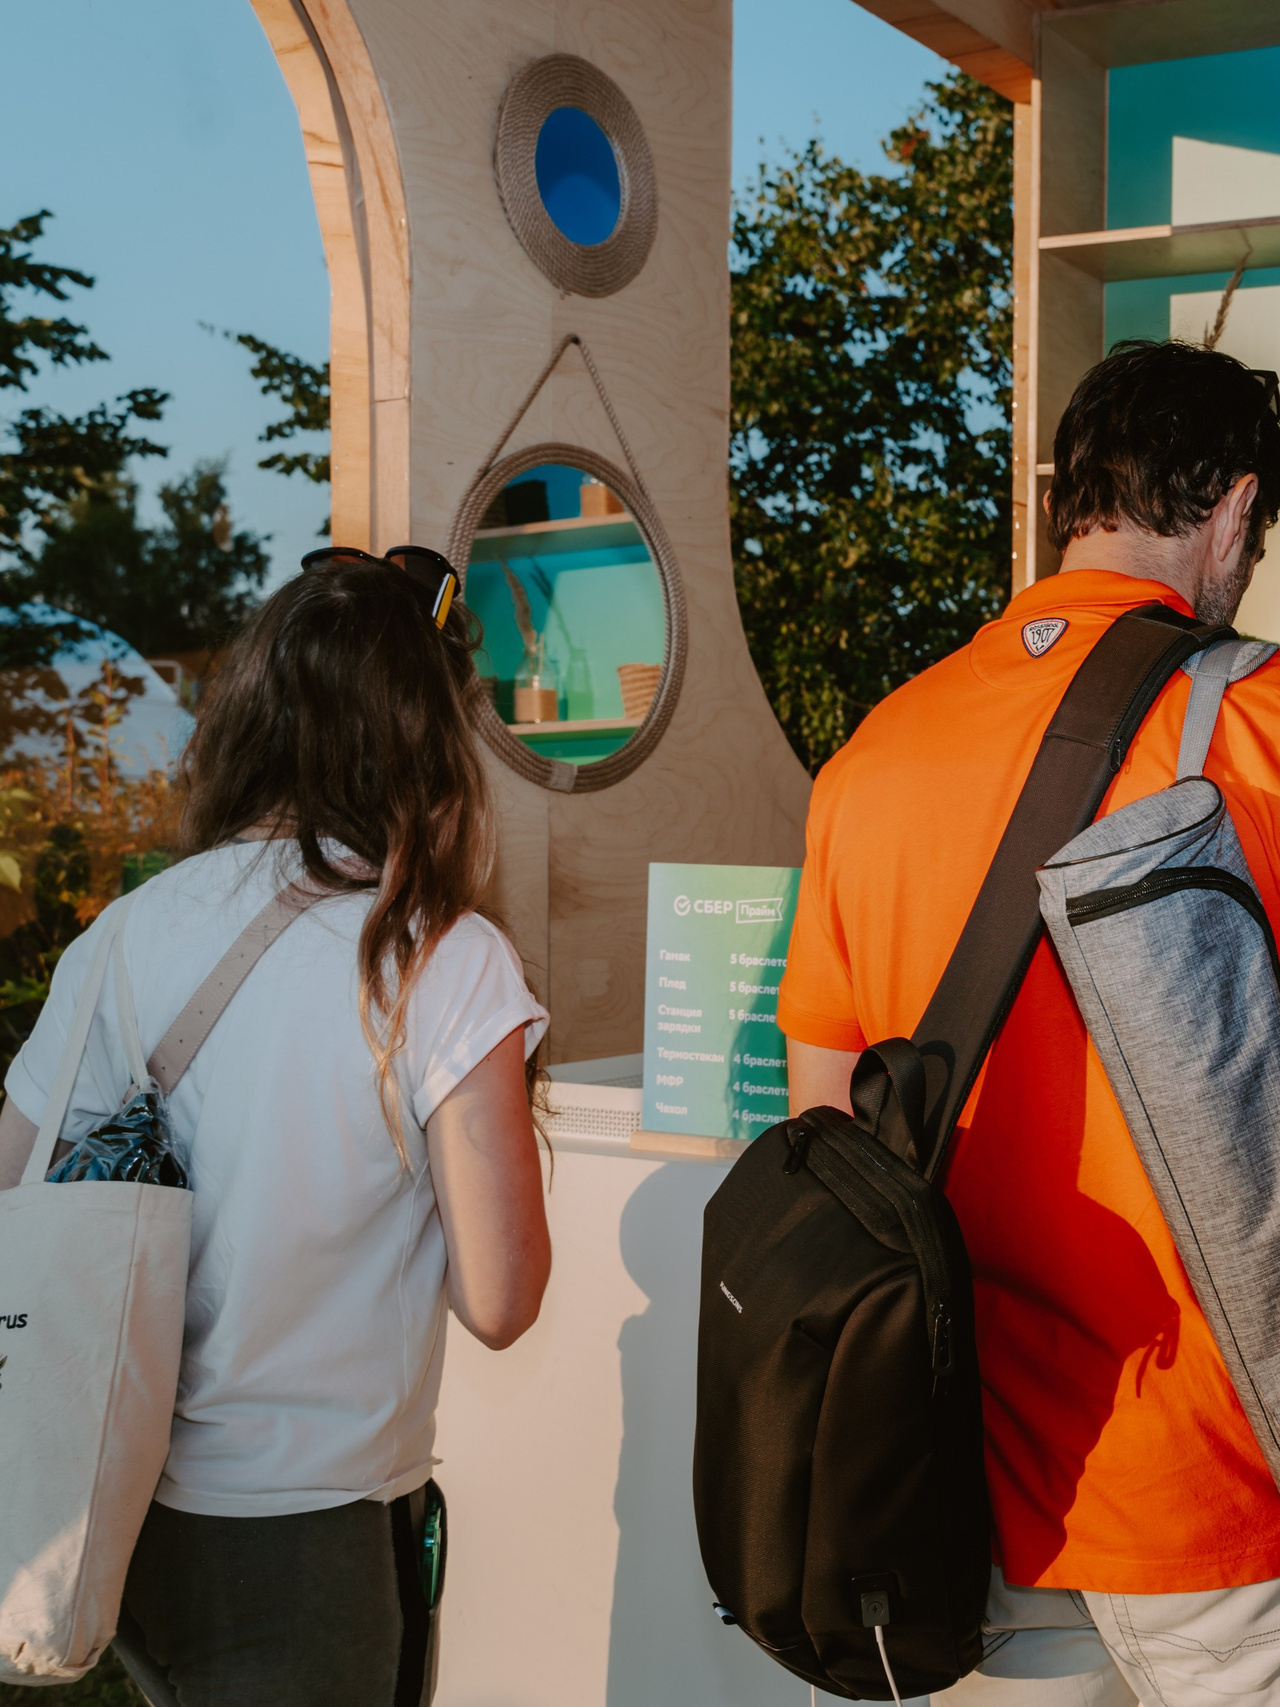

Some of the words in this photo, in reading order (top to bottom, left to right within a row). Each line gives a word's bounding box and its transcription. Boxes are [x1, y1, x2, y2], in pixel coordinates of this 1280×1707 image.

[1031, 627, 1055, 645] 1907
[693, 899, 733, 914] СБЕР
[740, 904, 776, 917] Прайм
[659, 949, 691, 962] Гамак
[730, 953, 737, 965] 5
[658, 976, 687, 990] Плед
[729, 981, 736, 993] 5
[657, 1004, 702, 1018] Станция
[728, 1009, 736, 1020] 5
[657, 1022, 701, 1034] зарядки
[657, 1047, 725, 1063] Термостакан
[734, 1053, 741, 1064] 4
[656, 1075, 684, 1087] МФР
[733, 1081, 740, 1093] 4
[655, 1102, 688, 1115] Чехол
[732, 1109, 740, 1120] 4
